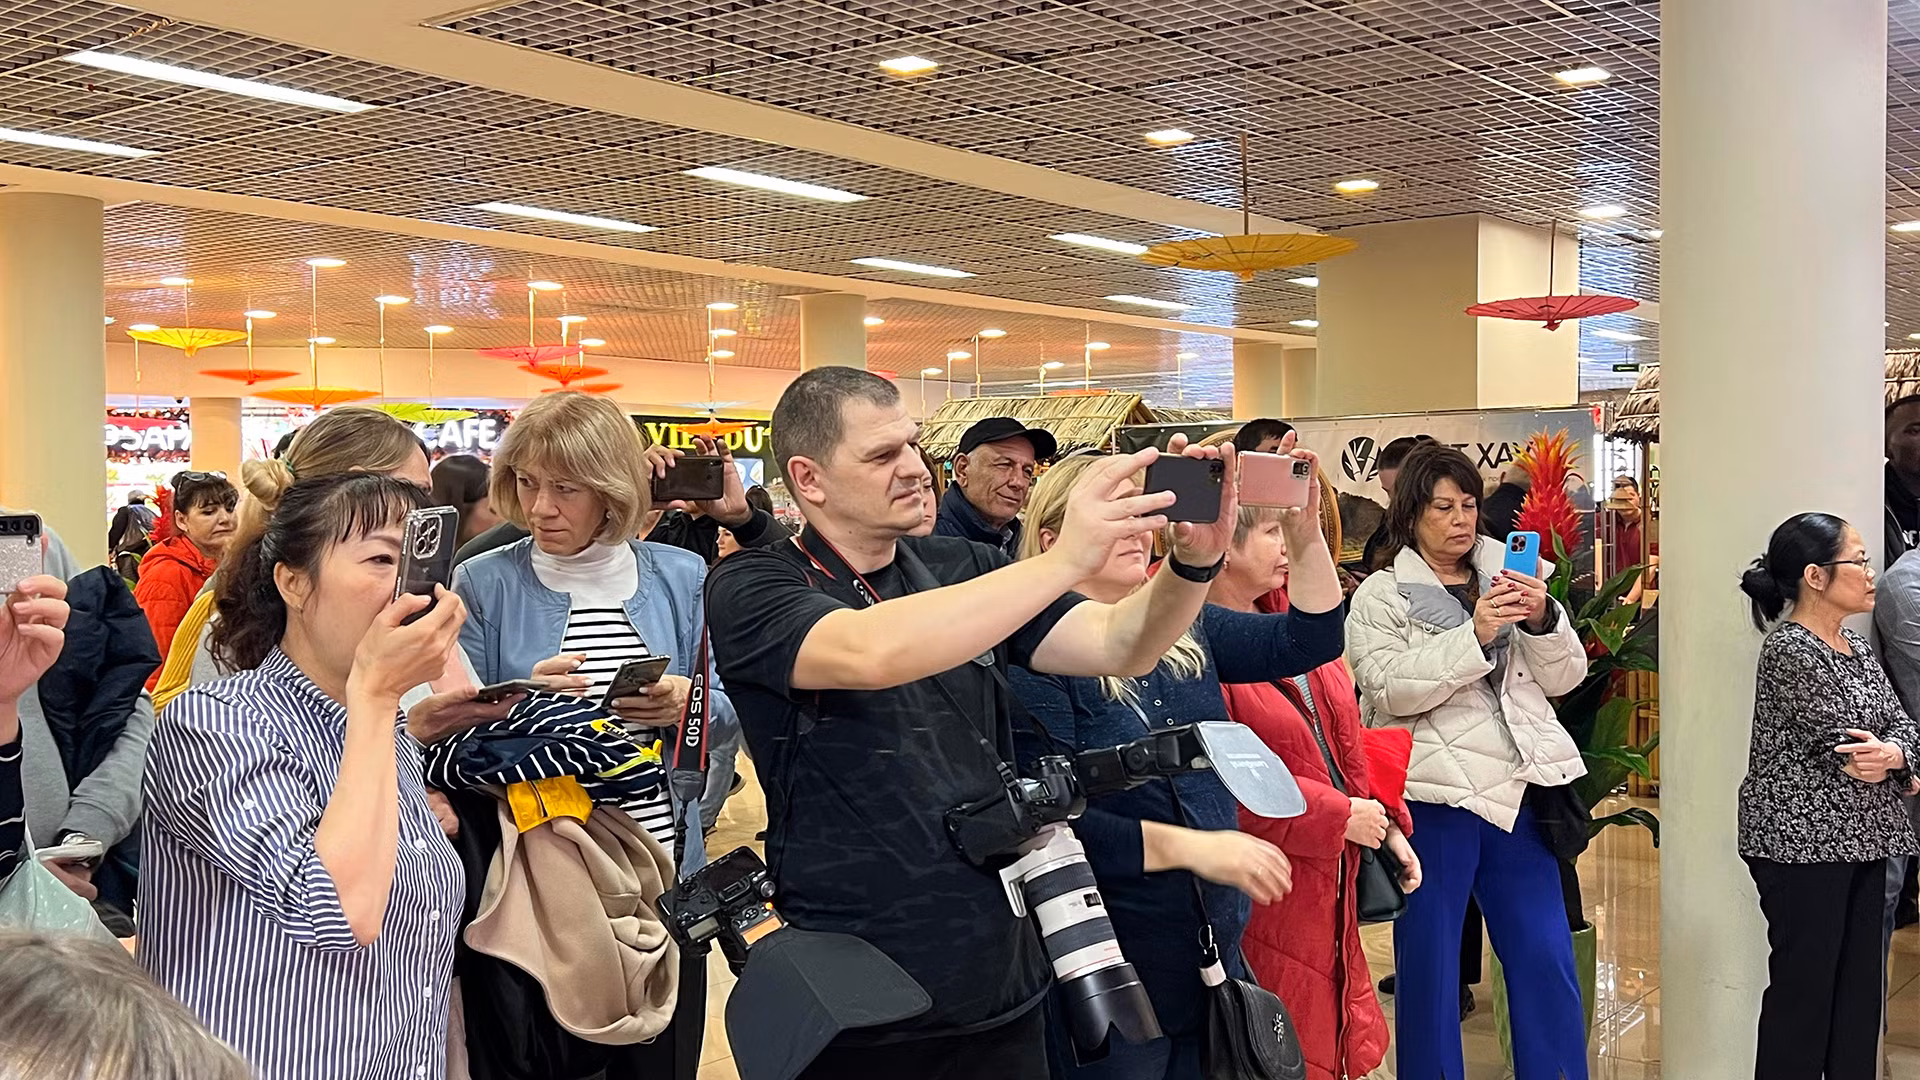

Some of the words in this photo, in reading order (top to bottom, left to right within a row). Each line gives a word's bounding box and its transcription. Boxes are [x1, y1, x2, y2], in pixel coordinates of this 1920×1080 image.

[411, 418, 497, 449] CAFE
[690, 673, 704, 714] EOS
[685, 718, 701, 748] 50D
